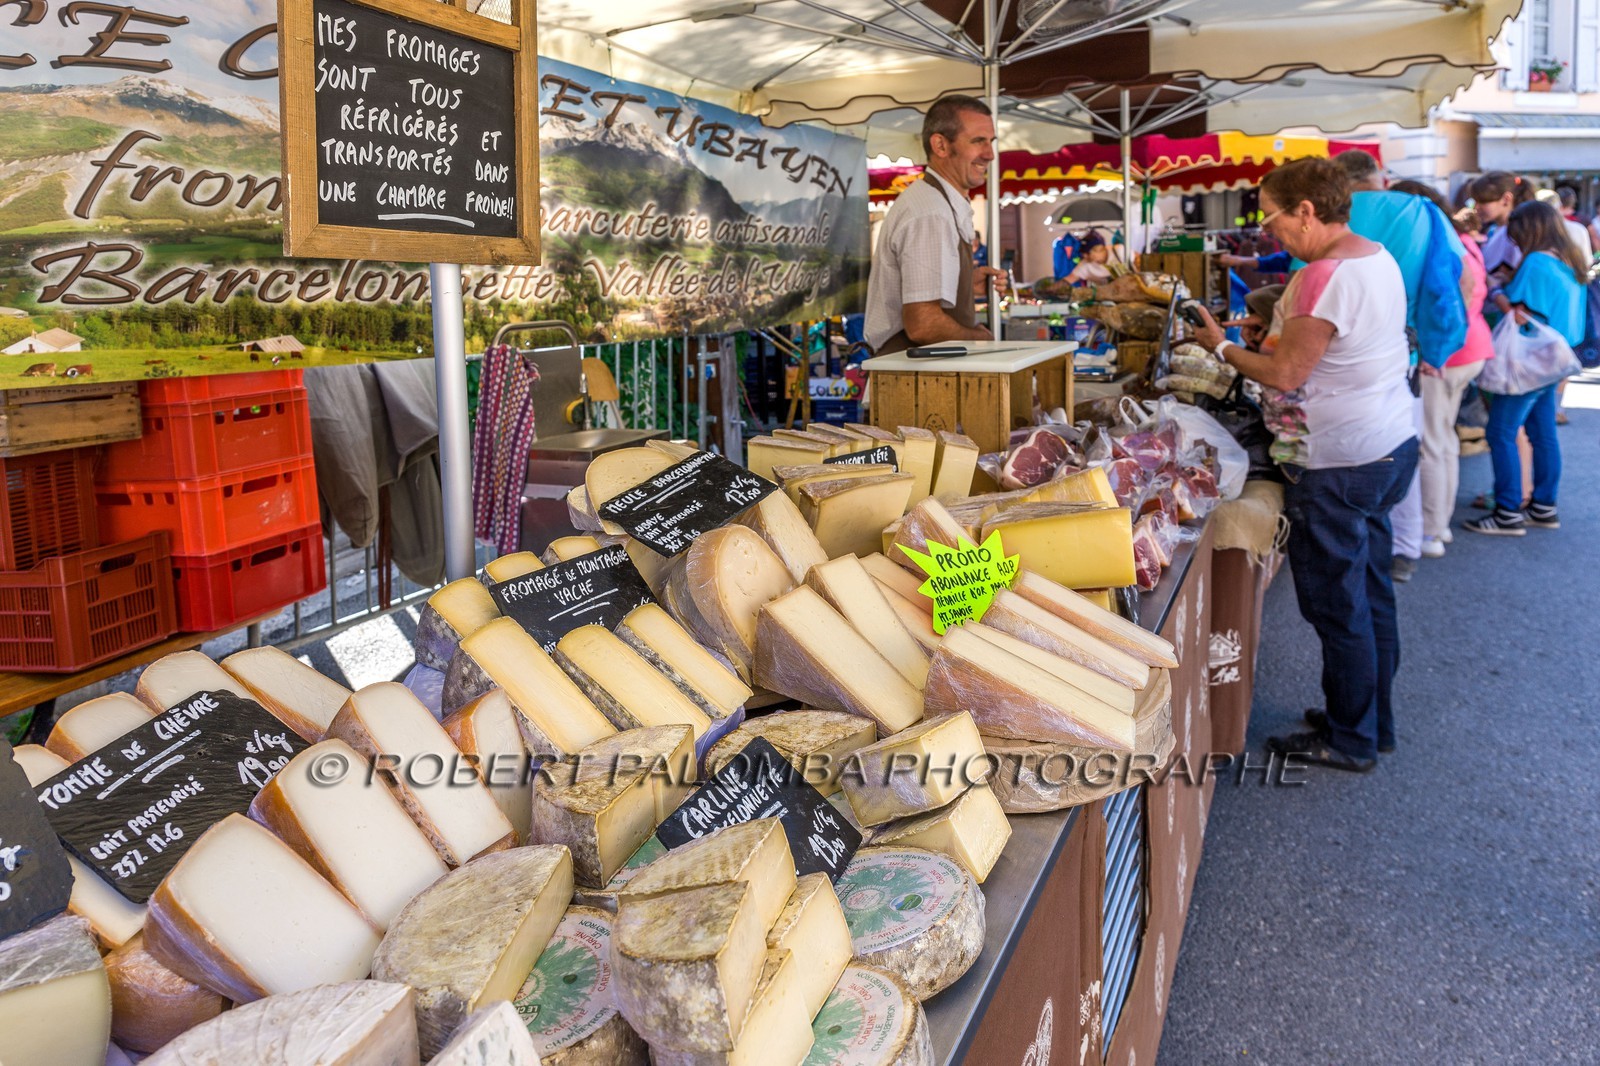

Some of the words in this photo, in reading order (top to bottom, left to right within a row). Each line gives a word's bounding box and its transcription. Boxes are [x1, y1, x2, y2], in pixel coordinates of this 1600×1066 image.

[318, 12, 357, 52] MES
[386, 29, 480, 76] FROMAGES
[315, 58, 376, 92] SONT
[409, 78, 463, 110] TOUS
[341, 98, 459, 146] RÉFRIGÉRÉS
[482, 131, 502, 152] ET
[540, 73, 647, 129] ET
[655, 106, 853, 199] UBAYEN
[321, 138, 453, 176] TRANSPORTÉS
[475, 160, 509, 183] DANS
[319, 180, 357, 203] UNE
[376, 182, 447, 209] CHAMBRE
[540, 201, 709, 240] arcuterie
[717, 212, 830, 243] artisanale
[31, 241, 562, 303] Barcelonette,
[584, 253, 699, 297] Vallée
[707, 254, 736, 294] de
[635, 513, 665, 533] UBAYE
[644, 528, 662, 541] LAIT
[662, 500, 703, 530] PASTEURISÉ
[654, 527, 683, 546] VACHE
[501, 567, 562, 603] FROMAGE
[566, 568, 576, 582] DE
[576, 550, 629, 575] MONTAGNE
[936, 548, 991, 572] PROMO
[554, 579, 593, 605] VACHE
[930, 568, 990, 594] ABONDANCE
[935, 591, 967, 608] MÉDAILLE
[969, 586, 987, 599] D'OR
[38, 757, 113, 810] TOMME
[121, 741, 146, 761] DE
[153, 693, 219, 740] CHÈVRE
[90, 830, 128, 860] LAIT
[128, 775, 204, 836] PASTEURISÉ
[682, 767, 749, 839] CARLINE
[574, 930, 602, 950] CARLINE
[871, 925, 908, 940] CARLINE
[598, 962, 611, 992] CARLINE
[848, 982, 872, 1001] CARLINE
[545, 1008, 588, 1036] CARLINE
[545, 1006, 609, 1050] CHAMBEYRON
[858, 1013, 877, 1046] CARLINE
